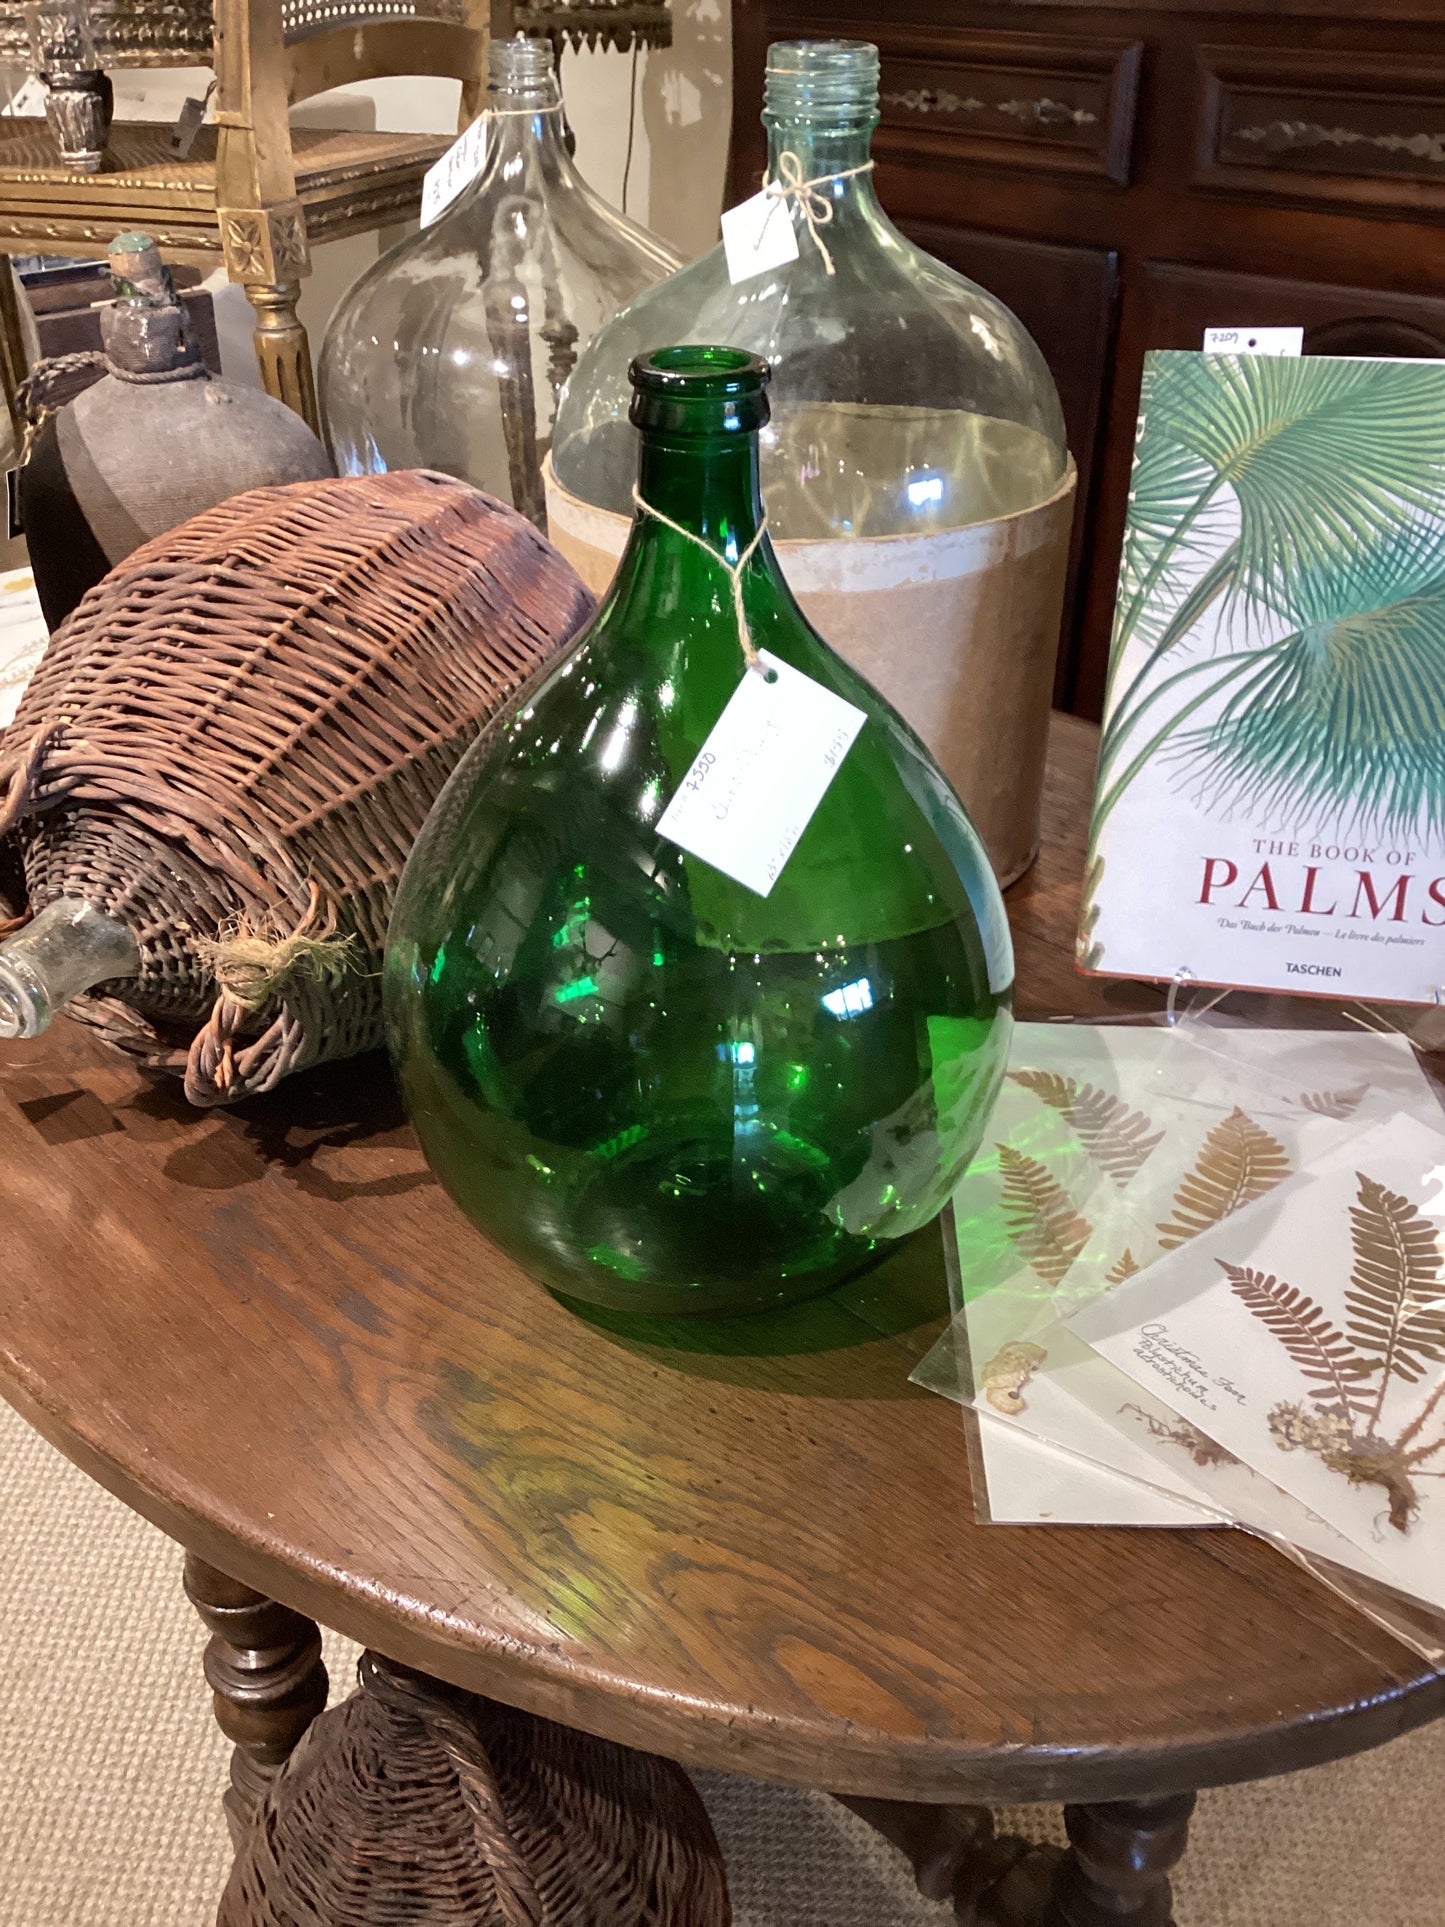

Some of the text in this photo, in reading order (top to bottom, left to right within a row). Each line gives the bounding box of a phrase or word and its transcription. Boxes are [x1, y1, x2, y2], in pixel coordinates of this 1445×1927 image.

[1210, 332, 1238, 344] 7209
[1253, 838, 1417, 866] THE BOOK OF
[1195, 856, 1445, 926] PALMS
[1217, 917, 1238, 929] Das
[1240, 919, 1266, 932] Buch
[1266, 922, 1283, 933] der
[1285, 924, 1320, 937] Palmen
[1334, 929, 1347, 939] Le
[1348, 930, 1369, 941] livre
[1370, 932, 1386, 943] des
[1385, 934, 1425, 946] palmiers
[1286, 962, 1343, 977] TASCHEN
